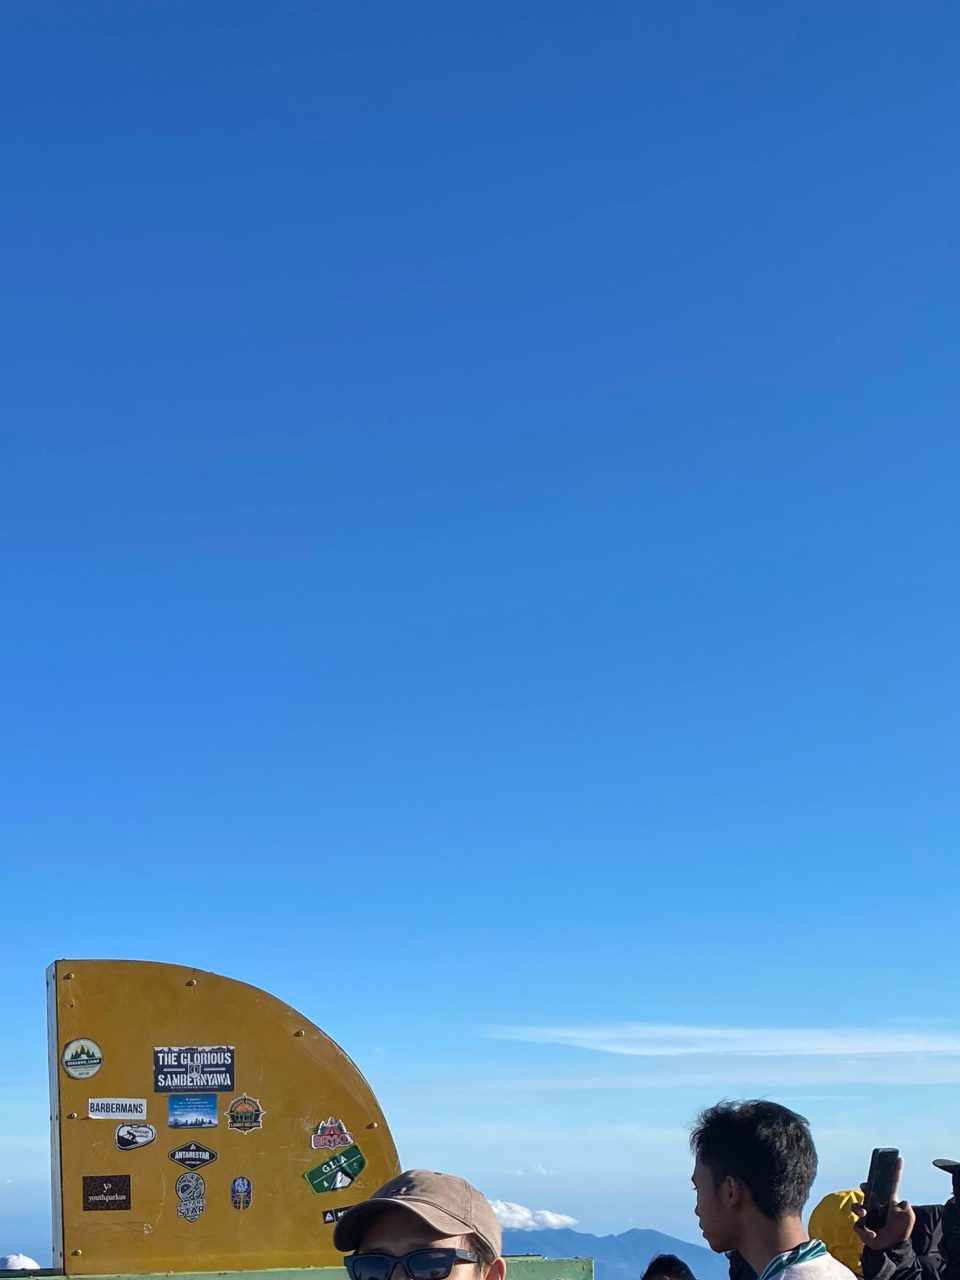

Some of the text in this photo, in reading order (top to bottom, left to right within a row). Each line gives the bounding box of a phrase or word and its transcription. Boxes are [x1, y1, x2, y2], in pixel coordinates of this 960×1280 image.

[157, 1052, 232, 1066] THE GLORIOUS
[157, 1073, 232, 1087] SAMBERNYAWA
[90, 1102, 144, 1114] BARBERMANS
[174, 1151, 210, 1161] ANTARESTAR
[178, 1206, 205, 1217] STAR
